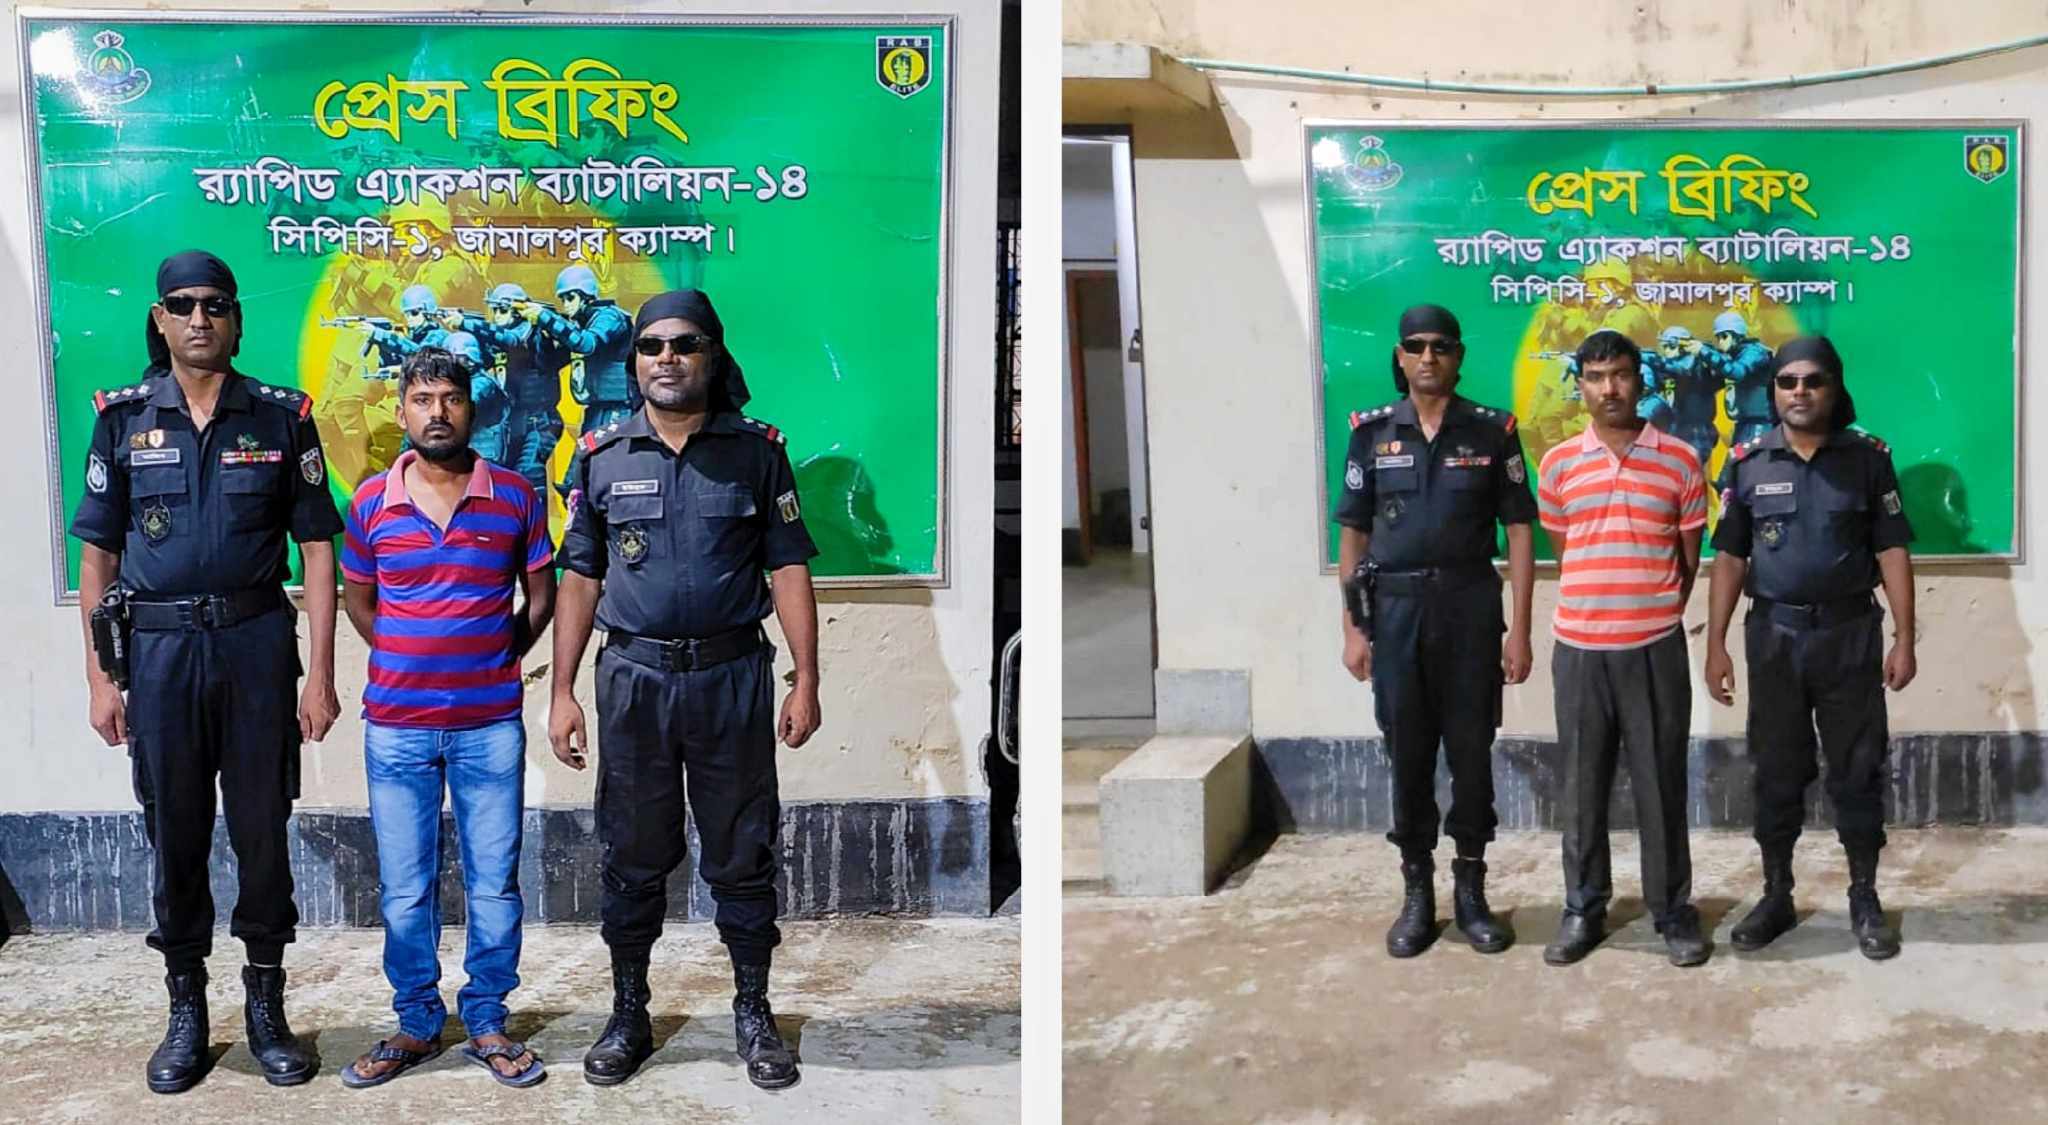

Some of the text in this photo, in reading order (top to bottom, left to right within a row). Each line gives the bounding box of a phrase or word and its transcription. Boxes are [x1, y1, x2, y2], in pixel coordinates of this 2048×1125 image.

[313, 58, 689, 148] প্রেস ব্রিফিং
[356, 163, 524, 205] এ্যাকশন
[531, 155, 808, 204] ব্যাটালিয়ন-১৪
[1526, 153, 1820, 222] প্রেস ব্রিফিং
[267, 215, 444, 261] সিপিসি-১,
[453, 223, 608, 261] জামালপুর
[1559, 234, 1688, 265] এ্যাকশন
[1696, 227, 1912, 264] ব্যাটালিয়ন-১৪
[1490, 274, 1625, 309] সিপিসি-১,
[1634, 280, 1753, 307] জামালপুর
